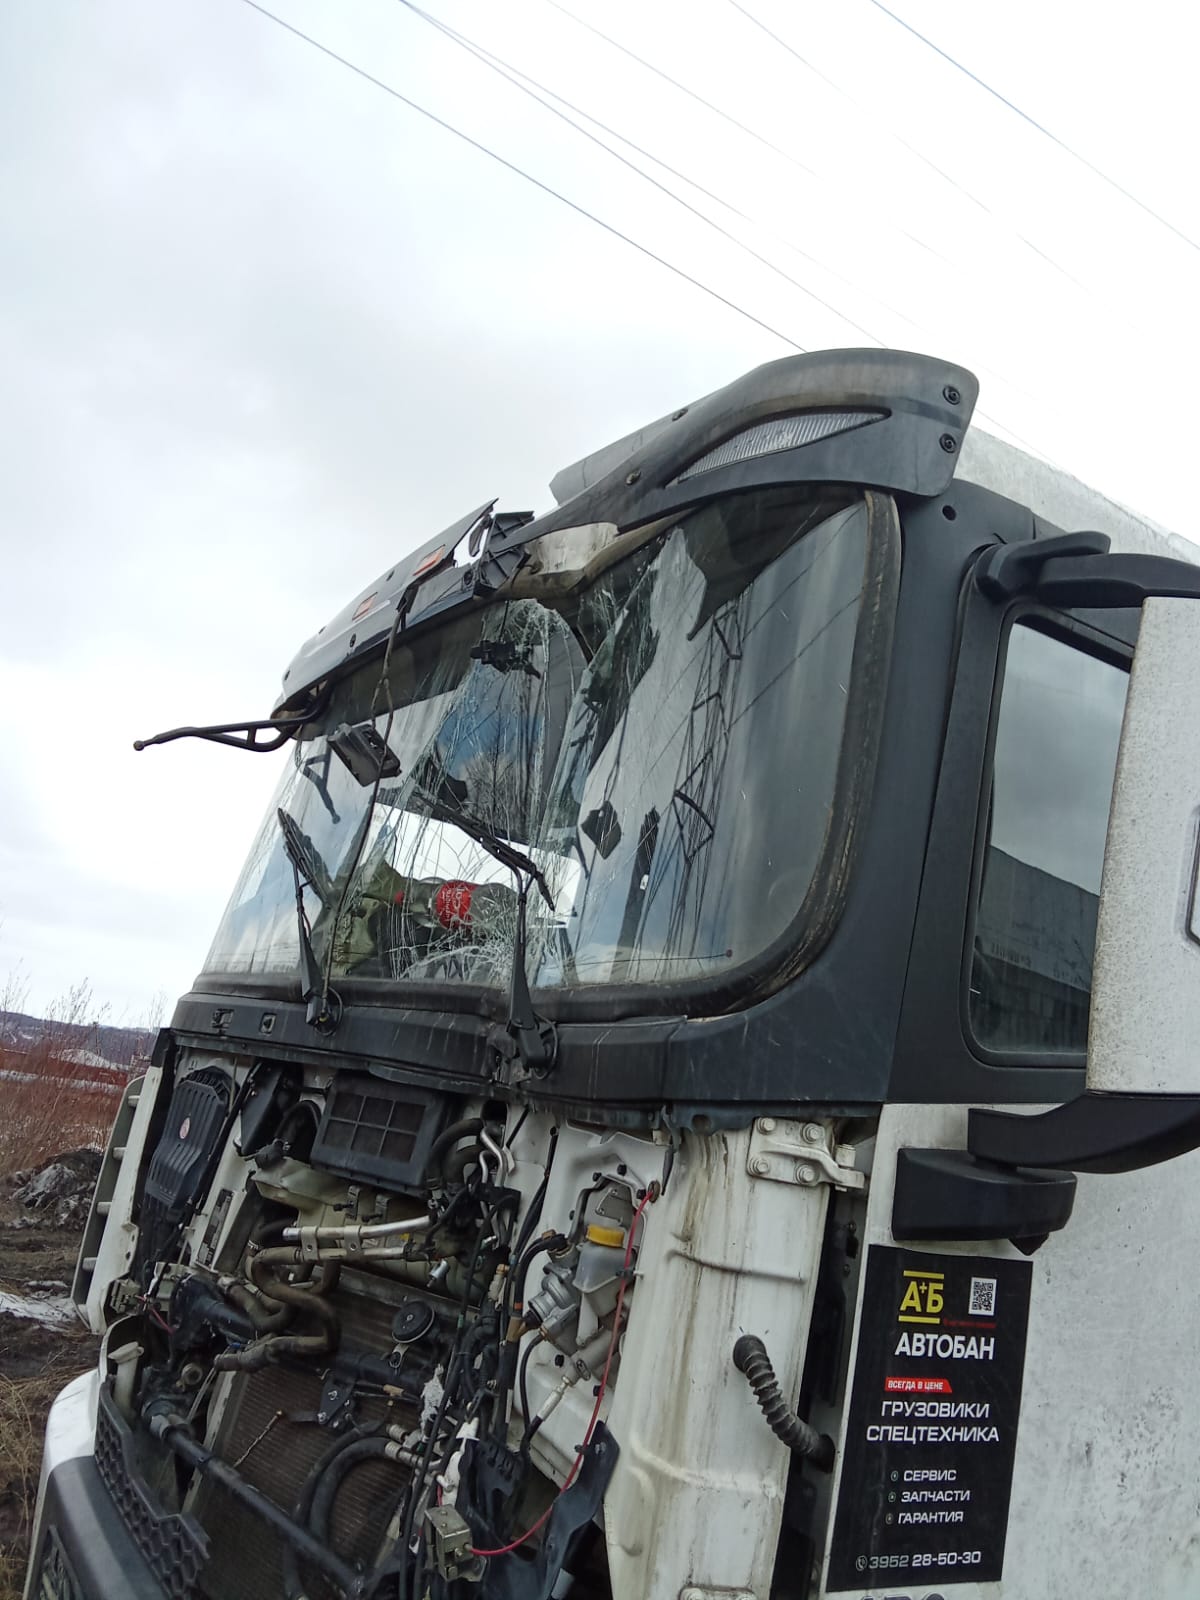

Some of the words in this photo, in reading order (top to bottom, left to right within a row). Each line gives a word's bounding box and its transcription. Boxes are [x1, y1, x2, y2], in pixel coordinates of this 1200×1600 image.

[894, 1332, 995, 1360] АВТОБАН
[887, 1380, 916, 1391] ВСЕГДА
[917, 1381, 924, 1390] В
[924, 1381, 944, 1391] ЦЕНЕ
[881, 1401, 990, 1418] ГРУЗОВИКИ
[866, 1425, 1000, 1444] СПЕЦТЕХНИКА
[903, 1470, 957, 1481] СЕРВИС
[901, 1490, 971, 1503] ЗАПЧАСТИ
[898, 1511, 964, 1524] ГАРАНТИЯ
[869, 1555, 910, 1569] 3952
[912, 1551, 982, 1567] 28-50-30
